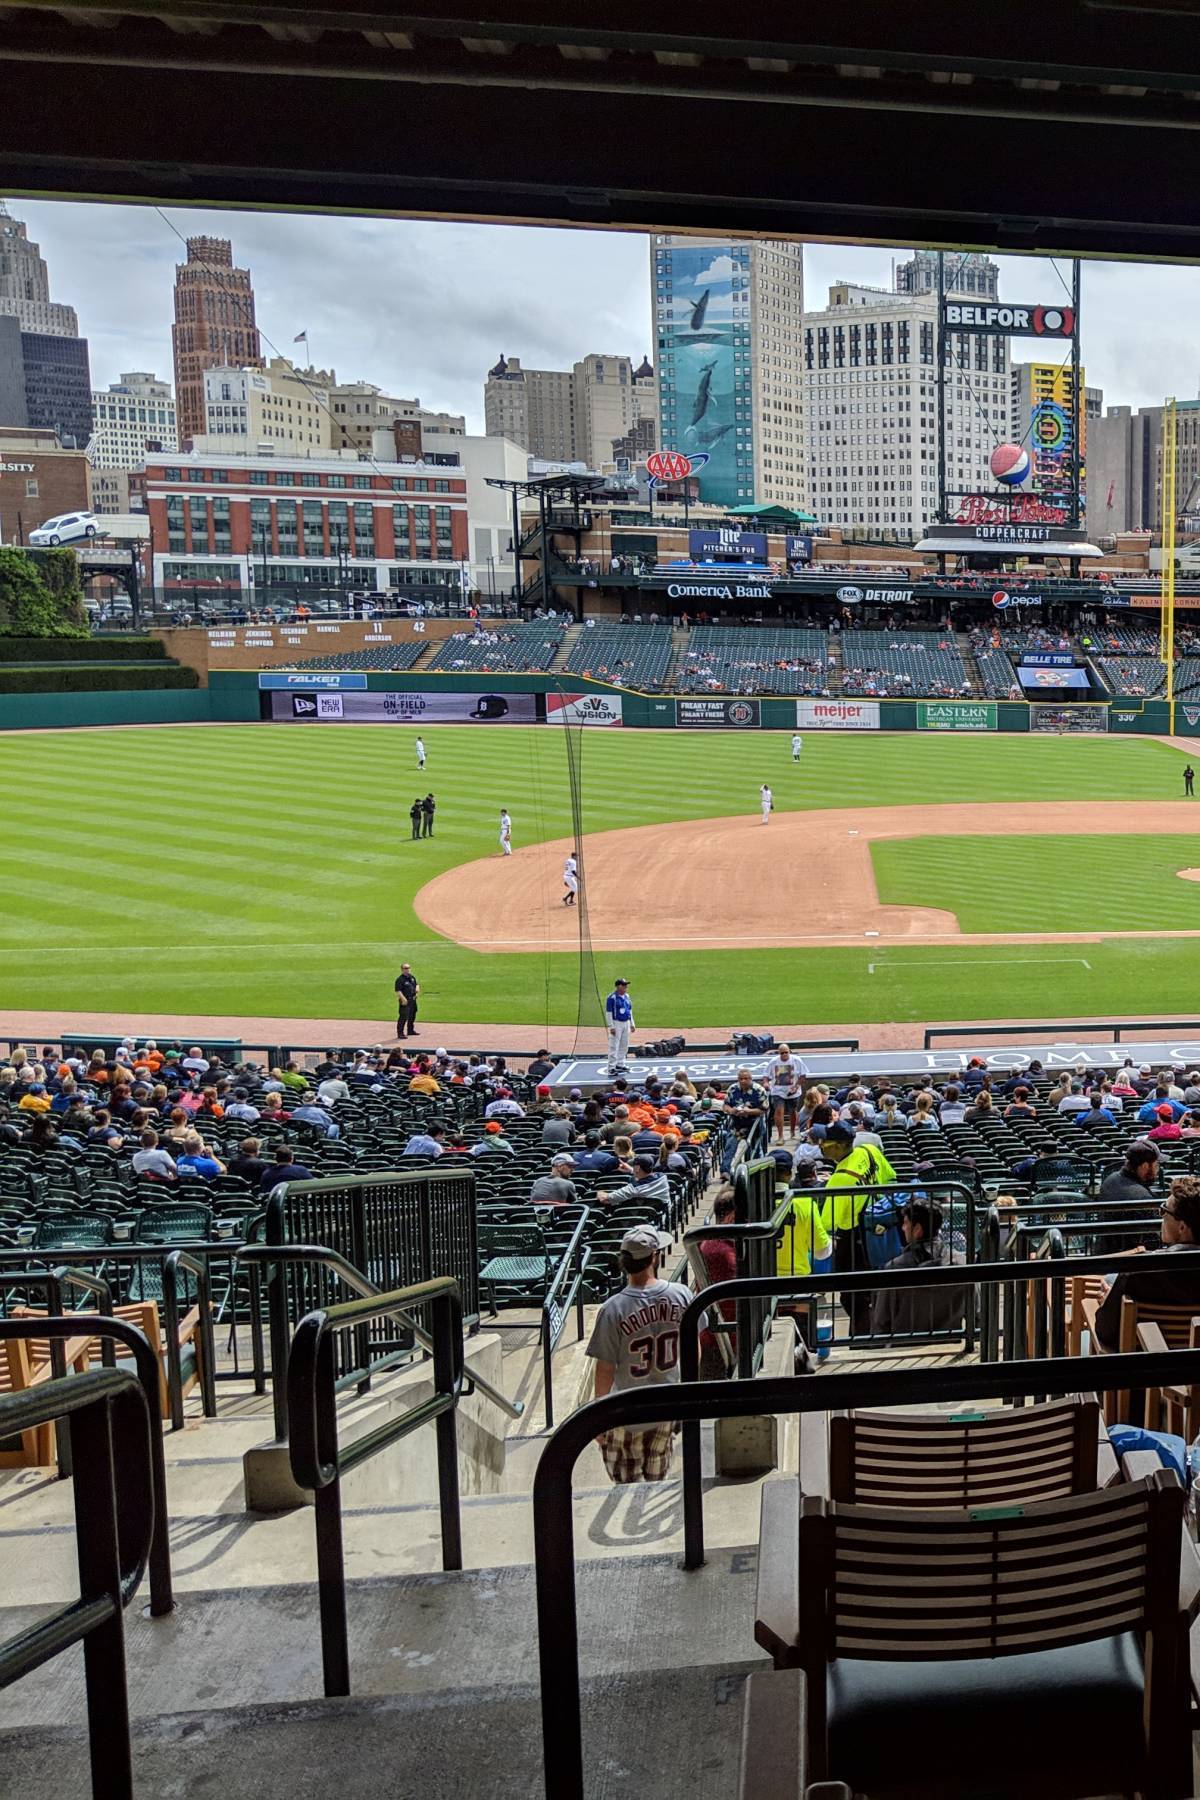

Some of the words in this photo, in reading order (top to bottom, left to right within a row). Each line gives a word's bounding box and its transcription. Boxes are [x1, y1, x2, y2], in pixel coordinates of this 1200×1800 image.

[947, 305, 1029, 328] BELFOR
[649, 453, 688, 479] AAA
[719, 528, 740, 545] Lite
[975, 527, 1050, 540] COPPERCRAFT
[703, 544, 740, 553] PITCHER'S
[742, 545, 755, 554] PUB
[735, 585, 772, 599] Bank
[865, 589, 914, 601] DETROIT
[1010, 595, 1042, 606] pepsi
[373, 623, 382, 633] 11
[413, 622, 425, 632] 42
[1023, 655, 1051, 664] BELLE
[1053, 655, 1072, 664] TIRE
[383, 700, 426, 709] ON-FIELD
[814, 702, 862, 720] meijer
[927, 704, 988, 717] EASTERN
[576, 711, 616, 719] VISION
[922, 1048, 1131, 1068] HOME
[620, 1296, 683, 1336] ORDOÑE
[630, 1330, 678, 1377] 30
